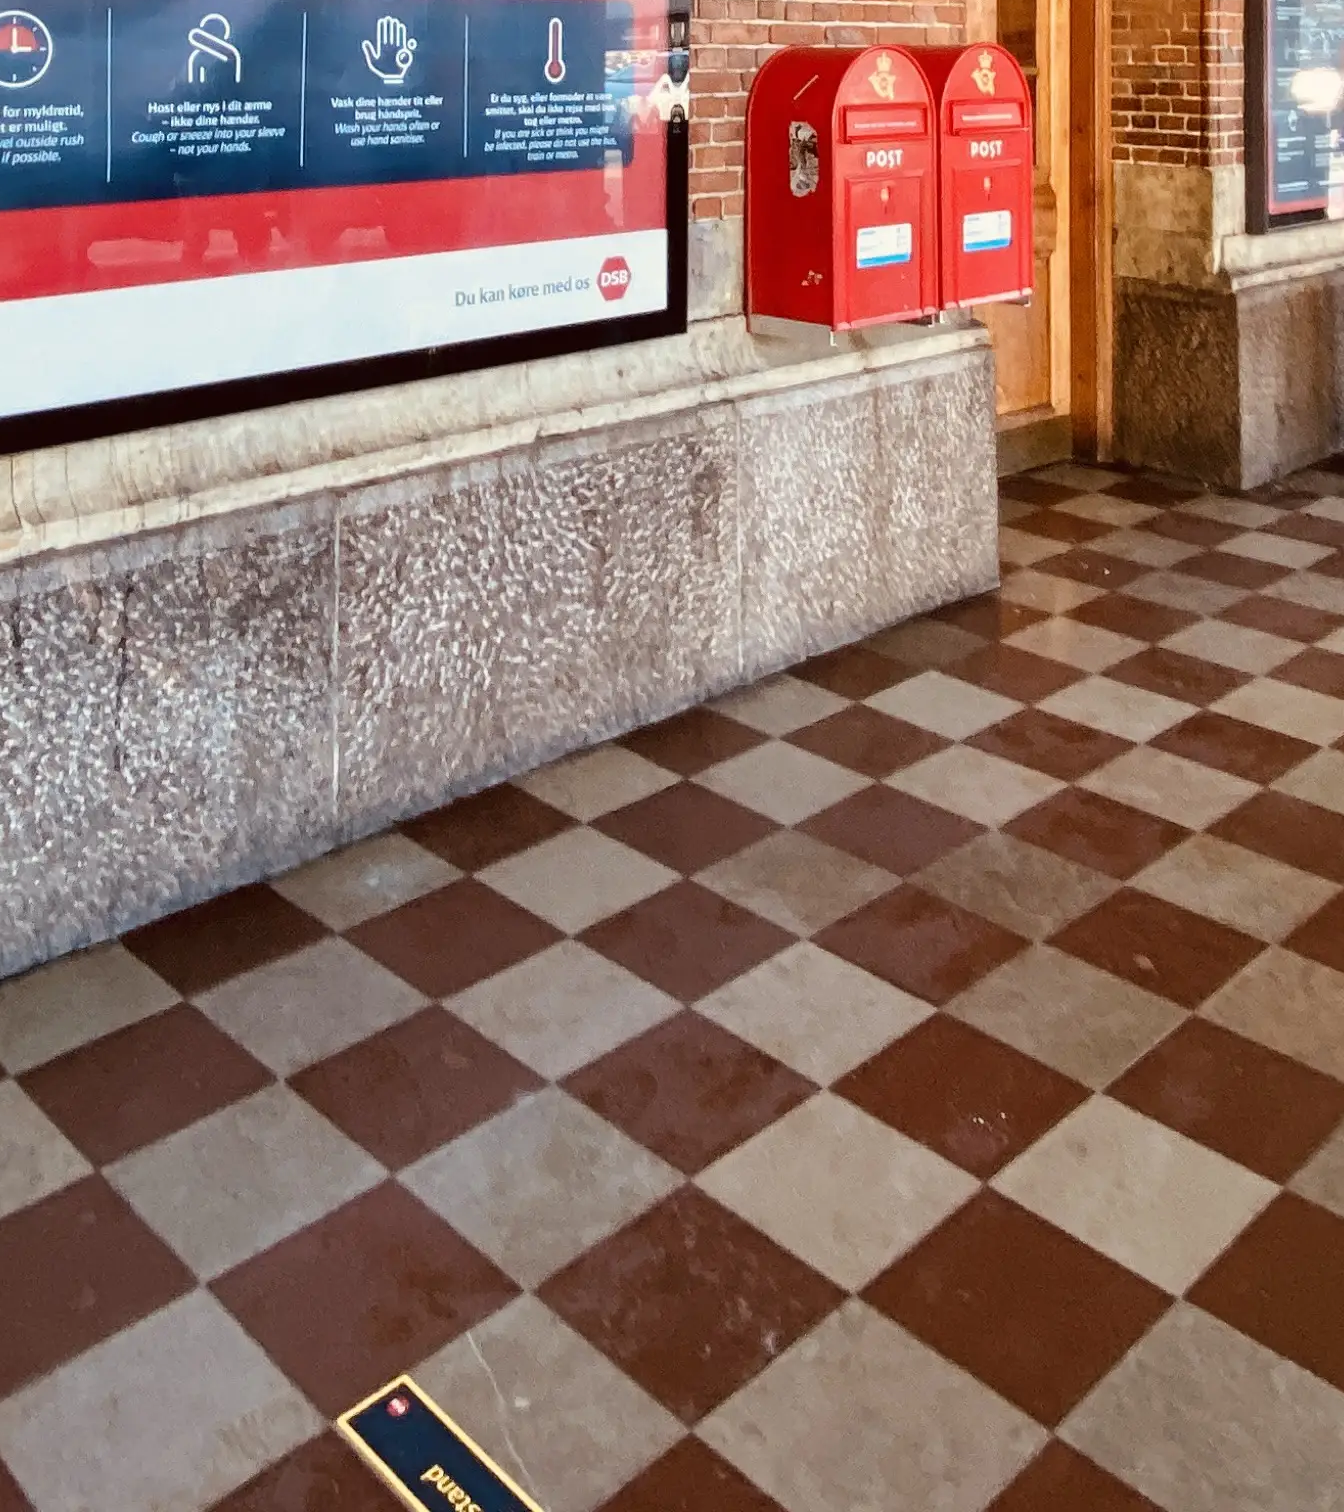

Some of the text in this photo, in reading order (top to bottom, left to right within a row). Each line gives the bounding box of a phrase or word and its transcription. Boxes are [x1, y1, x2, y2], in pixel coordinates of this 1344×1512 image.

[2, 106, 20, 117] for
[148, 102, 174, 114] Host
[177, 101, 200, 112] eller
[203, 102, 220, 114] nys
[228, 100, 242, 111] dit
[9, 123, 22, 132] er
[24, 120, 67, 134] muligt.
[15, 136, 57, 147] outside
[60, 134, 84, 146] rush
[132, 127, 285, 143] Cough or sneeze into your sleeve
[178, 145, 195, 155] not
[196, 143, 219, 156] your
[970, 140, 1003, 158] POST
[1, 152, 10, 164] if
[866, 149, 903, 168] POST
[601, 270, 628, 288] DSB
[455, 276, 590, 306] Du kan køre med os
